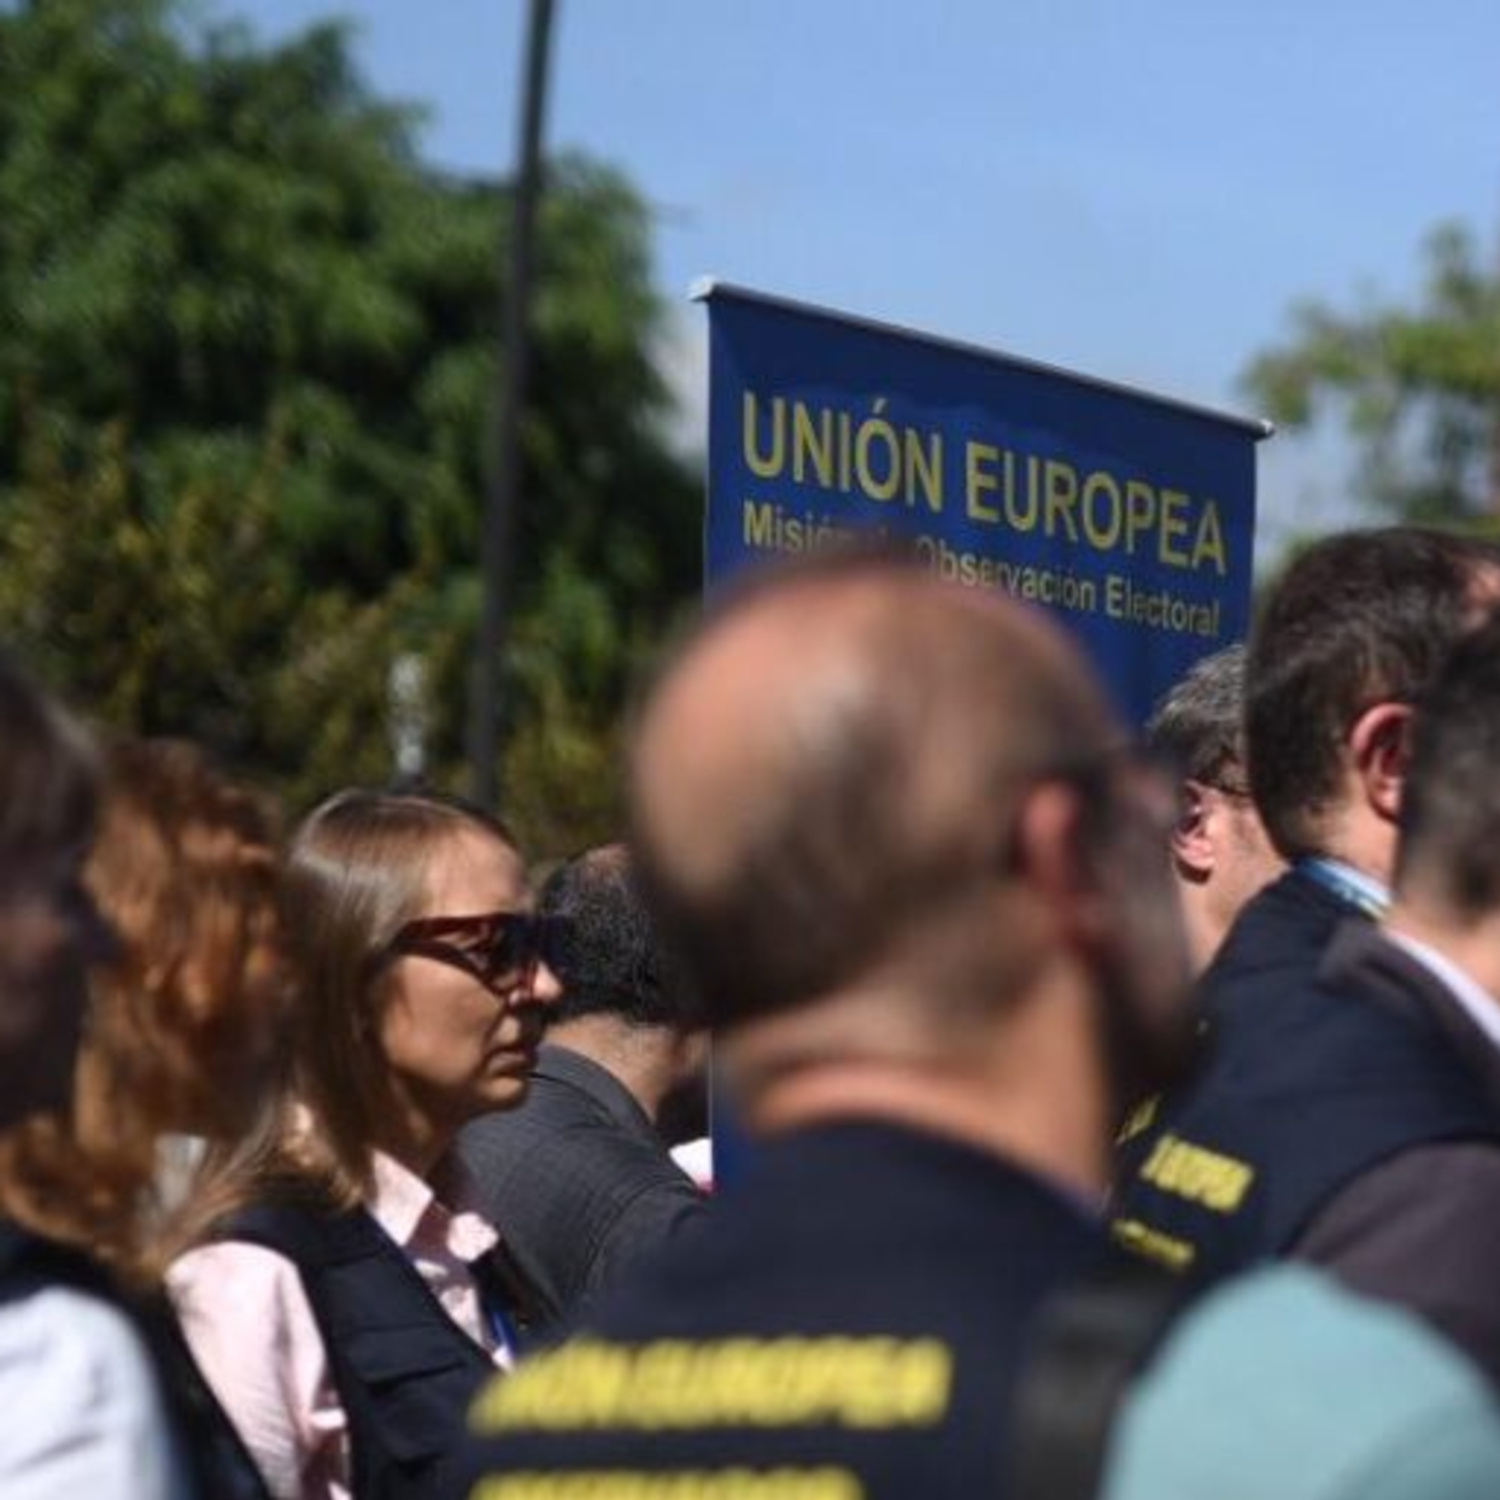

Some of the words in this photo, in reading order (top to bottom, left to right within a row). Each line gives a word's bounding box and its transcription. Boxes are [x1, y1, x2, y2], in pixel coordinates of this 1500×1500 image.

[743, 391, 944, 513] UNIÓN
[965, 440, 1227, 575] EUROPEA
[1105, 574, 1220, 636] Electoral
